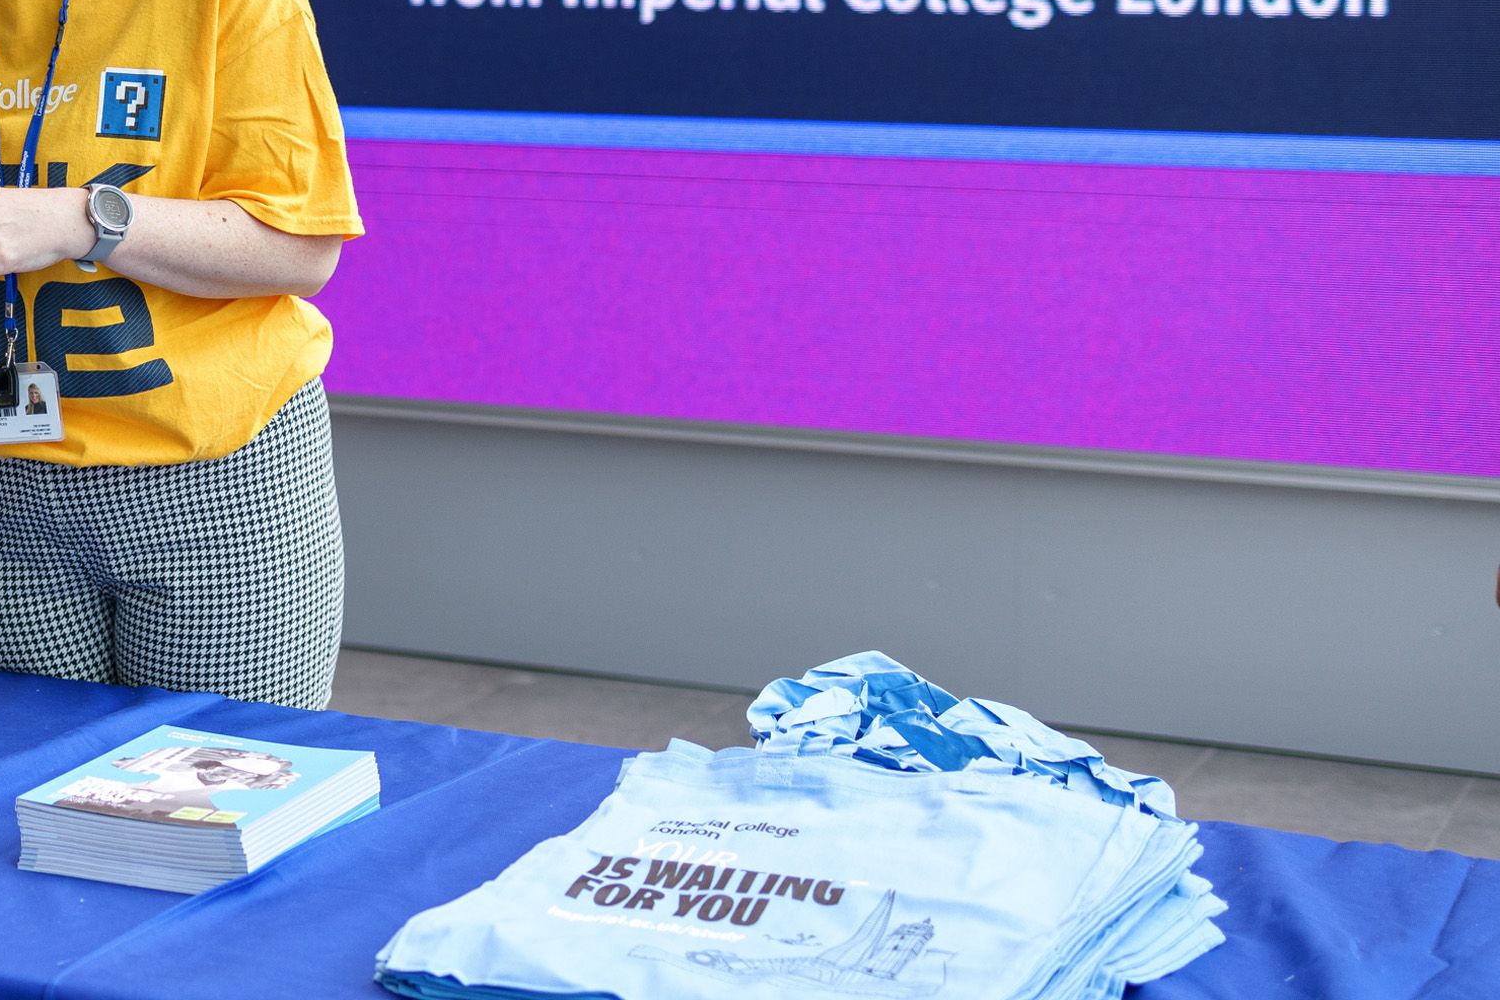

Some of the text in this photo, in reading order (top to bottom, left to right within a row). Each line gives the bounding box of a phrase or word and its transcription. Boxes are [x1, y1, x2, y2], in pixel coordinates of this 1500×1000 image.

[733, 821, 800, 838] College
[631, 837, 739, 868] YOUR
[564, 874, 771, 927] FOR YOU
[587, 855, 847, 907] IS WAITING
